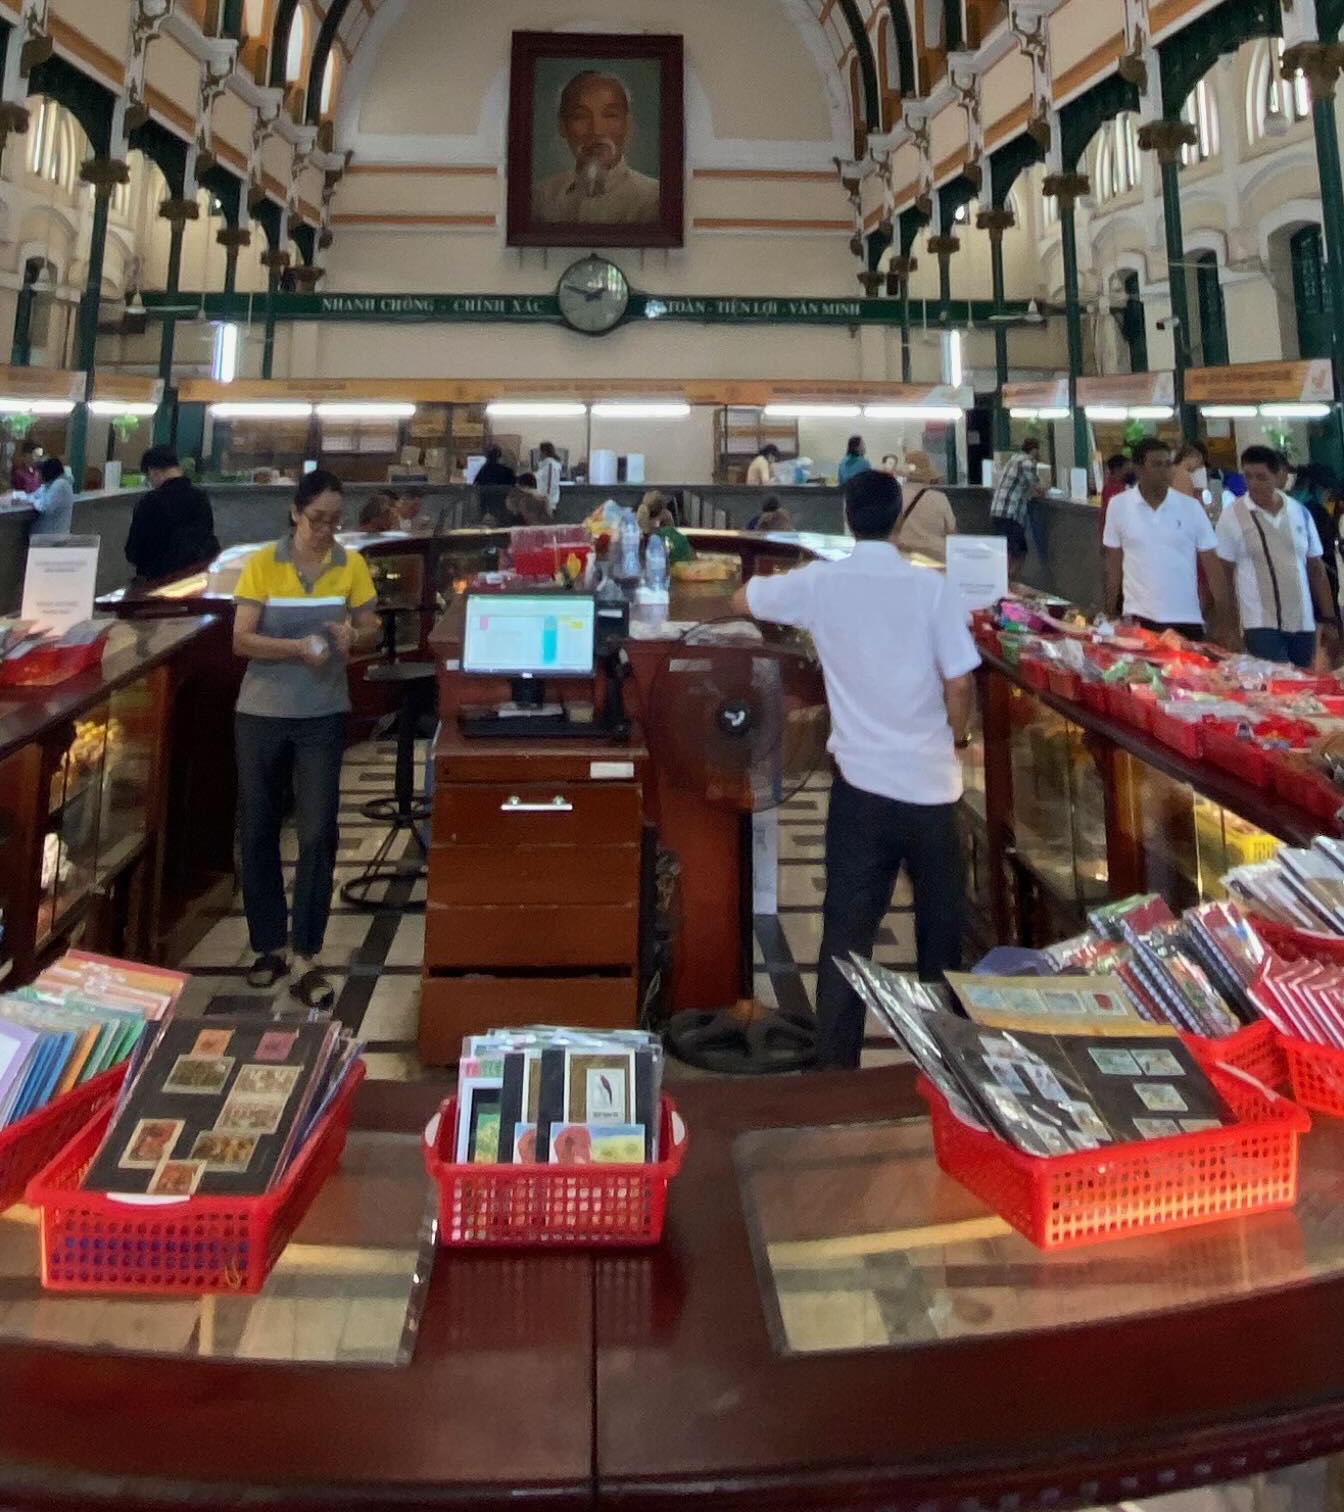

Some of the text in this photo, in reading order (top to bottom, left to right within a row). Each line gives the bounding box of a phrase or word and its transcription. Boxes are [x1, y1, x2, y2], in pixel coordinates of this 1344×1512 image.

[322, 297, 374, 313] NHANH
[454, 296, 505, 313] CHÍNH
[512, 296, 543, 313] XÁC
[822, 302, 861, 316] MINH
